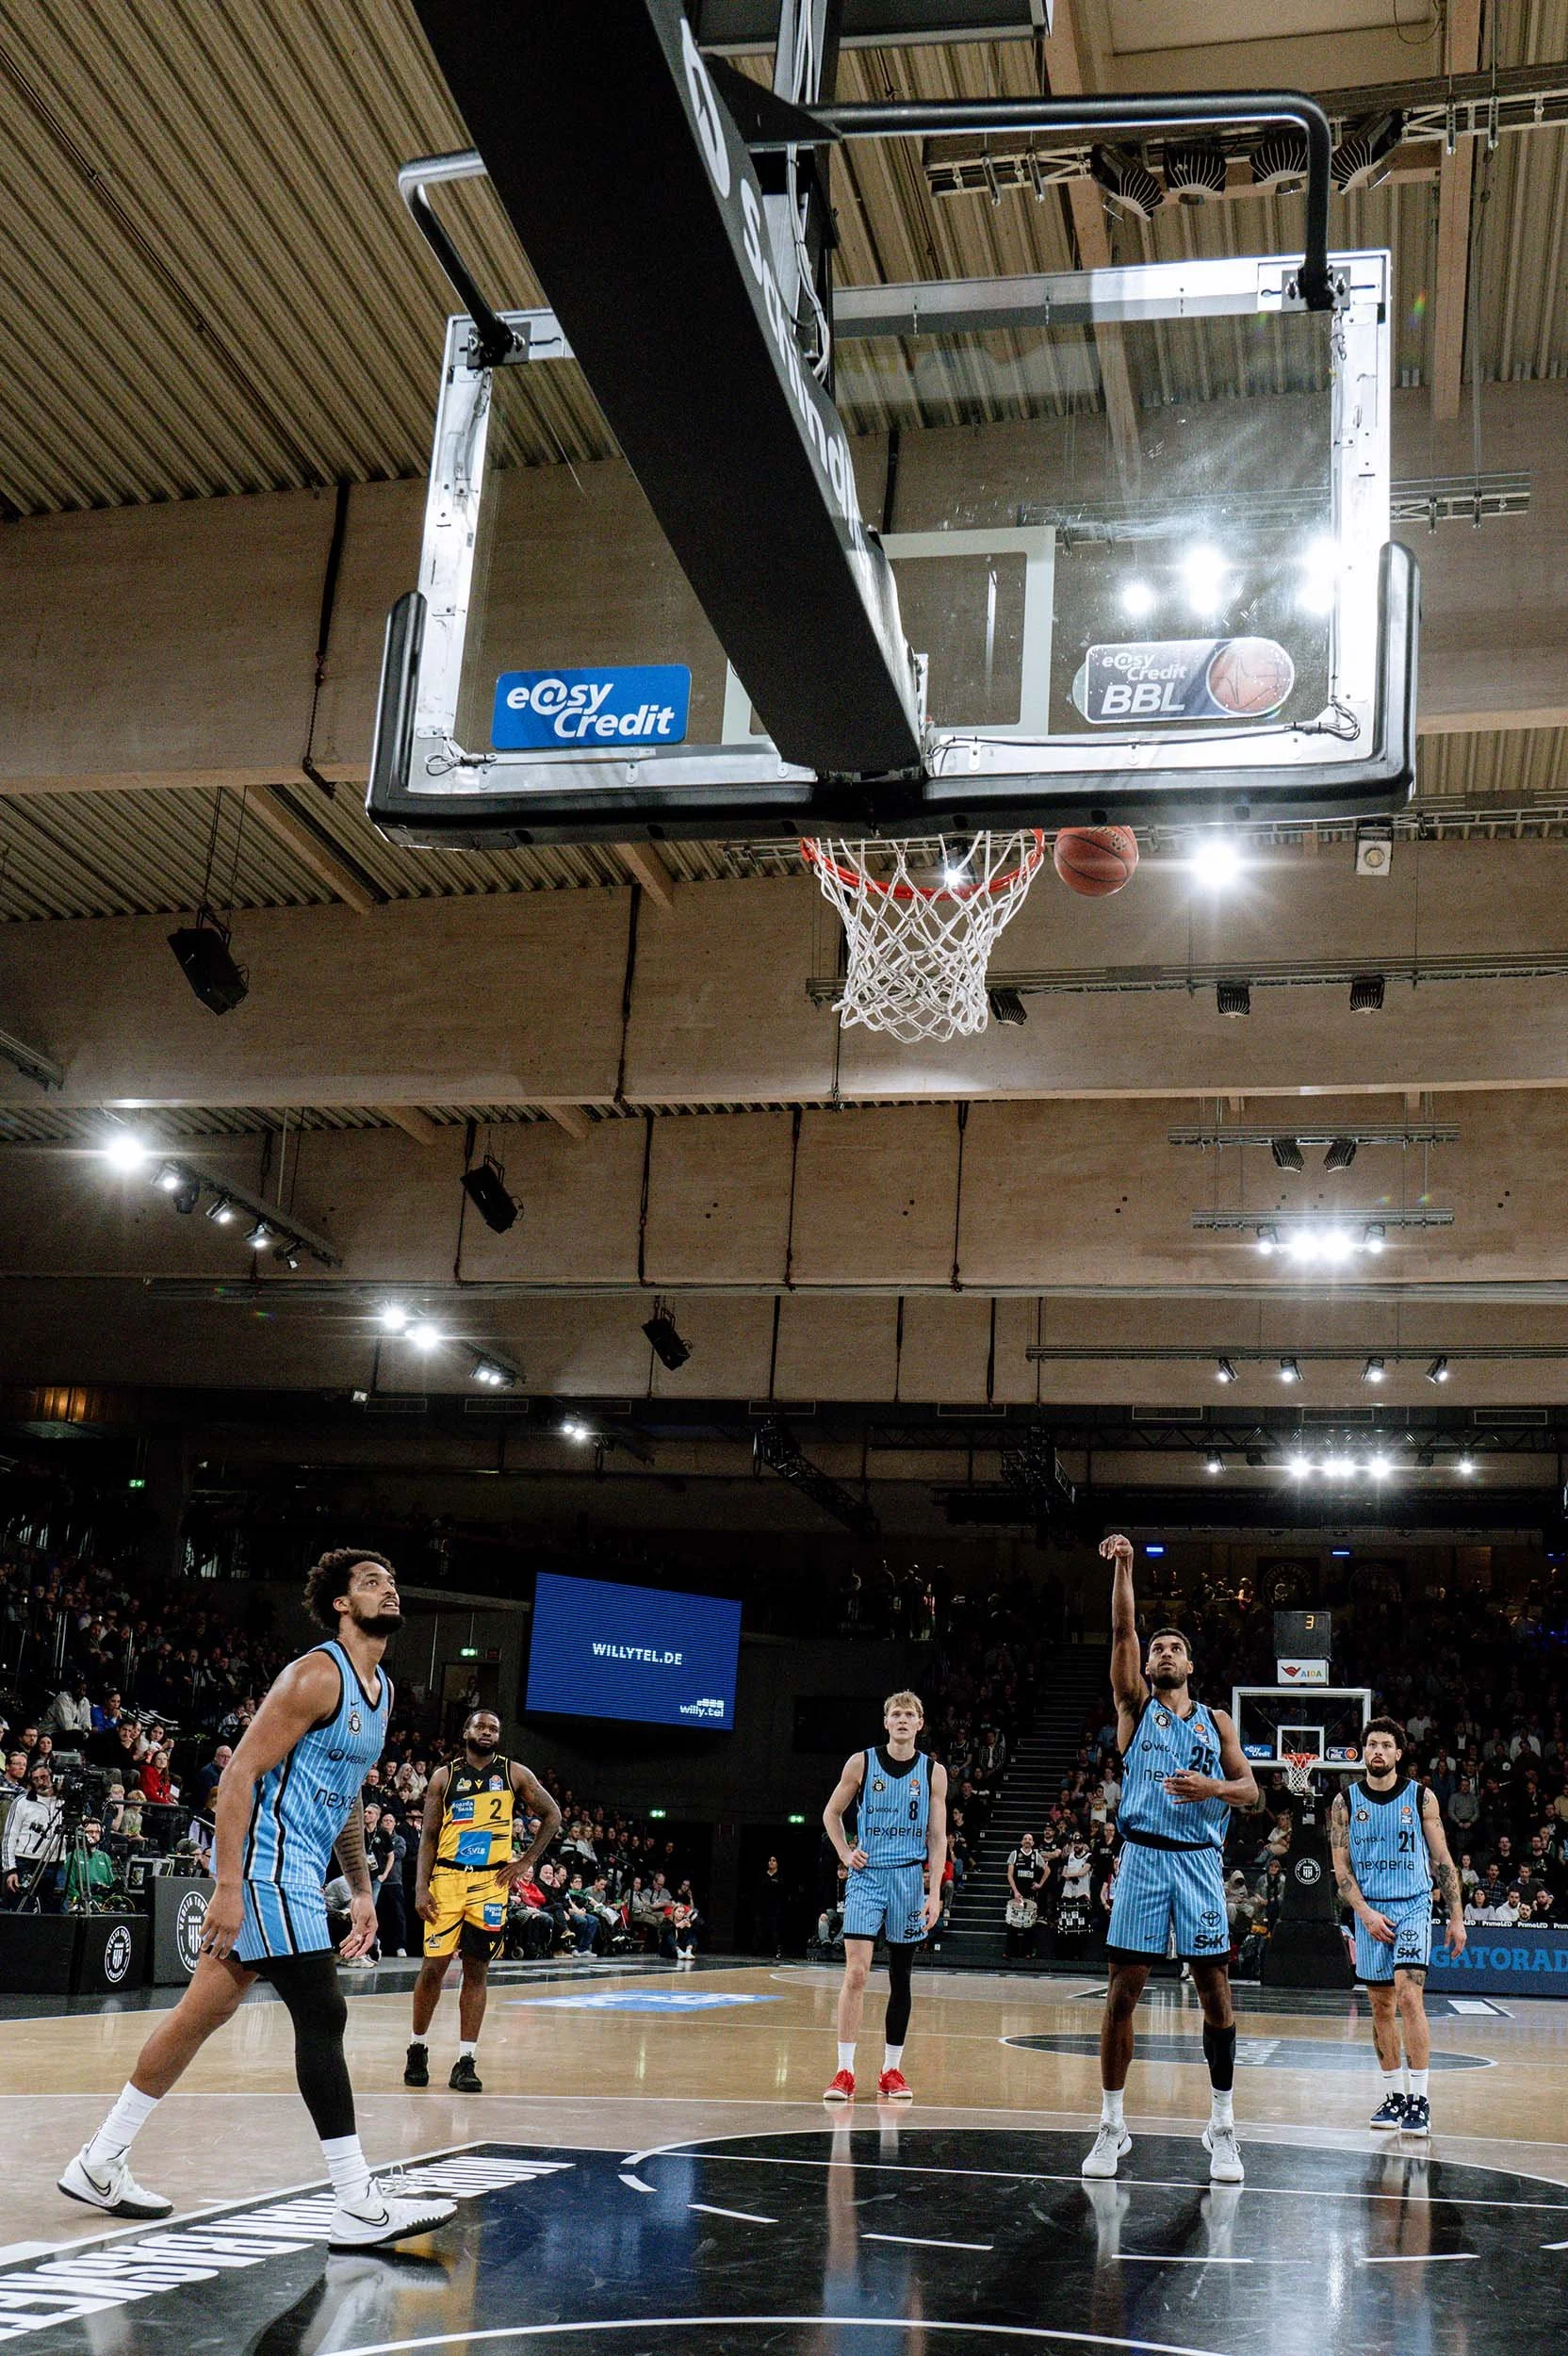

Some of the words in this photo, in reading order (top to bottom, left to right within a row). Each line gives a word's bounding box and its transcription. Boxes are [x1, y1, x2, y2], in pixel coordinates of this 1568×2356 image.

[1127, 664, 1187, 681] Credit
[1101, 681, 1185, 714] BBL
[554, 705, 675, 738] Credit
[1305, 1615, 1315, 1629] 3
[592, 1643, 682, 1665] WILLYTEL.DE
[1300, 1669, 1322, 1677] AIDA
[679, 1704, 724, 1717] willy.tel
[1189, 1745, 1215, 1775] 25
[489, 1798, 502, 1820] 2
[909, 1800, 918, 1821] 8
[865, 1825, 923, 1840] nexperia
[1398, 1830, 1415, 1853] 21
[1357, 1858, 1414, 1873] nexperia
